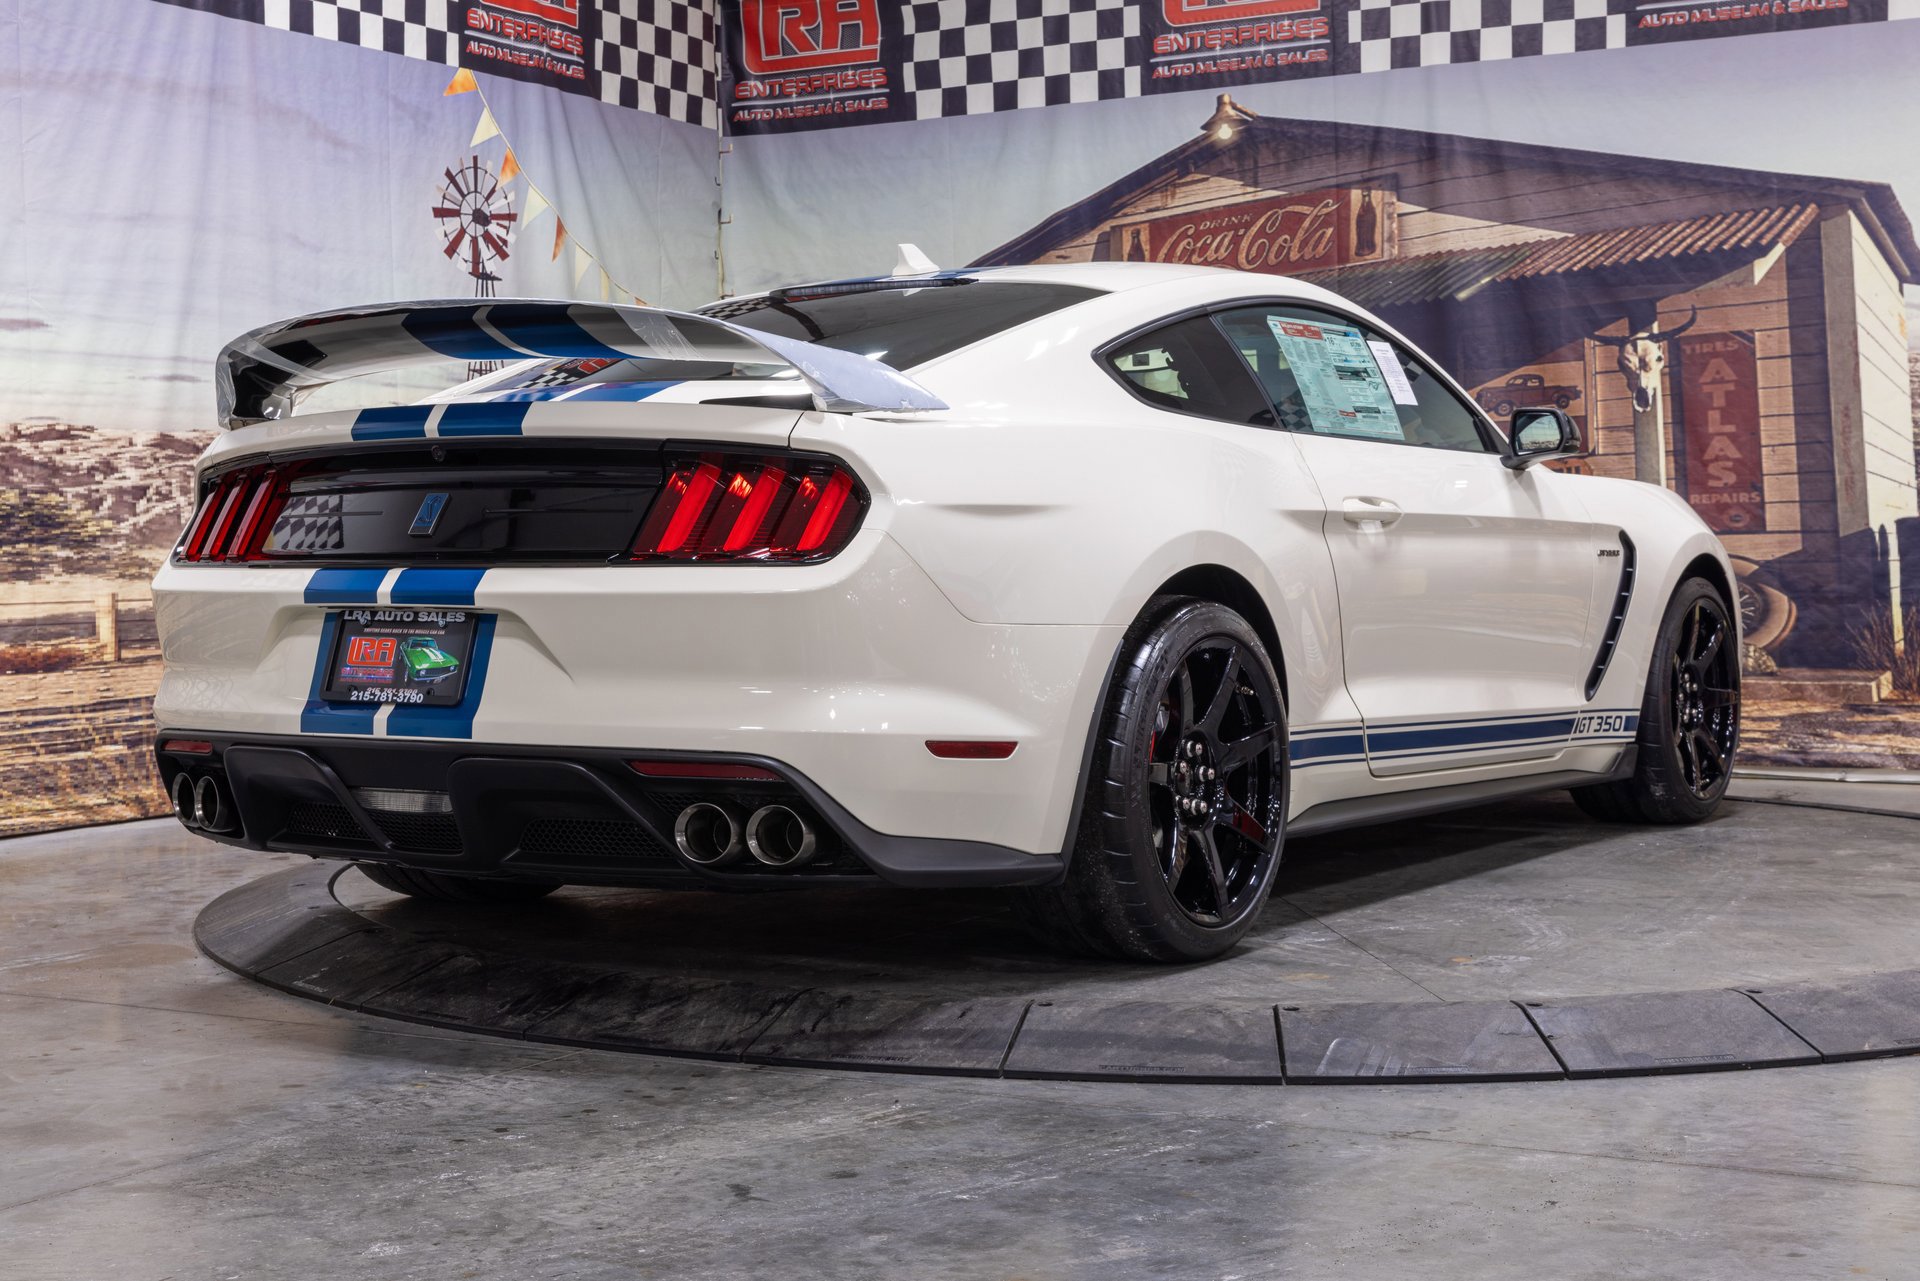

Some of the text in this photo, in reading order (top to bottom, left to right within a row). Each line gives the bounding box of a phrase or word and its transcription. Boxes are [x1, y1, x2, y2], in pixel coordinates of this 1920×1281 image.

[1638, 0, 1849, 29] AUTO MUSEUM & SALES
[466, 8, 584, 55] ENTERPRISES
[1153, 17, 1329, 54] ENTERPRISES
[466, 41, 496, 59] AUTO
[497, 47, 544, 69] MUSEUM
[1152, 49, 1328, 79] AUTO MUSEUM & SALES
[735, 67, 887, 99] ENTERPRISES
[733, 97, 888, 121] AUTO MUSEUM & SALES
[1156, 199, 1342, 270] Coca-Cola
[1199, 212, 1252, 231] DRINK
[1682, 339, 1739, 355] TIRES
[1699, 357, 1743, 487] ATLAS
[1690, 491, 1761, 505] REPAIRS
[343, 610, 466, 623] LRA AUTO SALES
[347, 636, 397, 667] LRA
[350, 691, 424, 703] 215-781-3790
